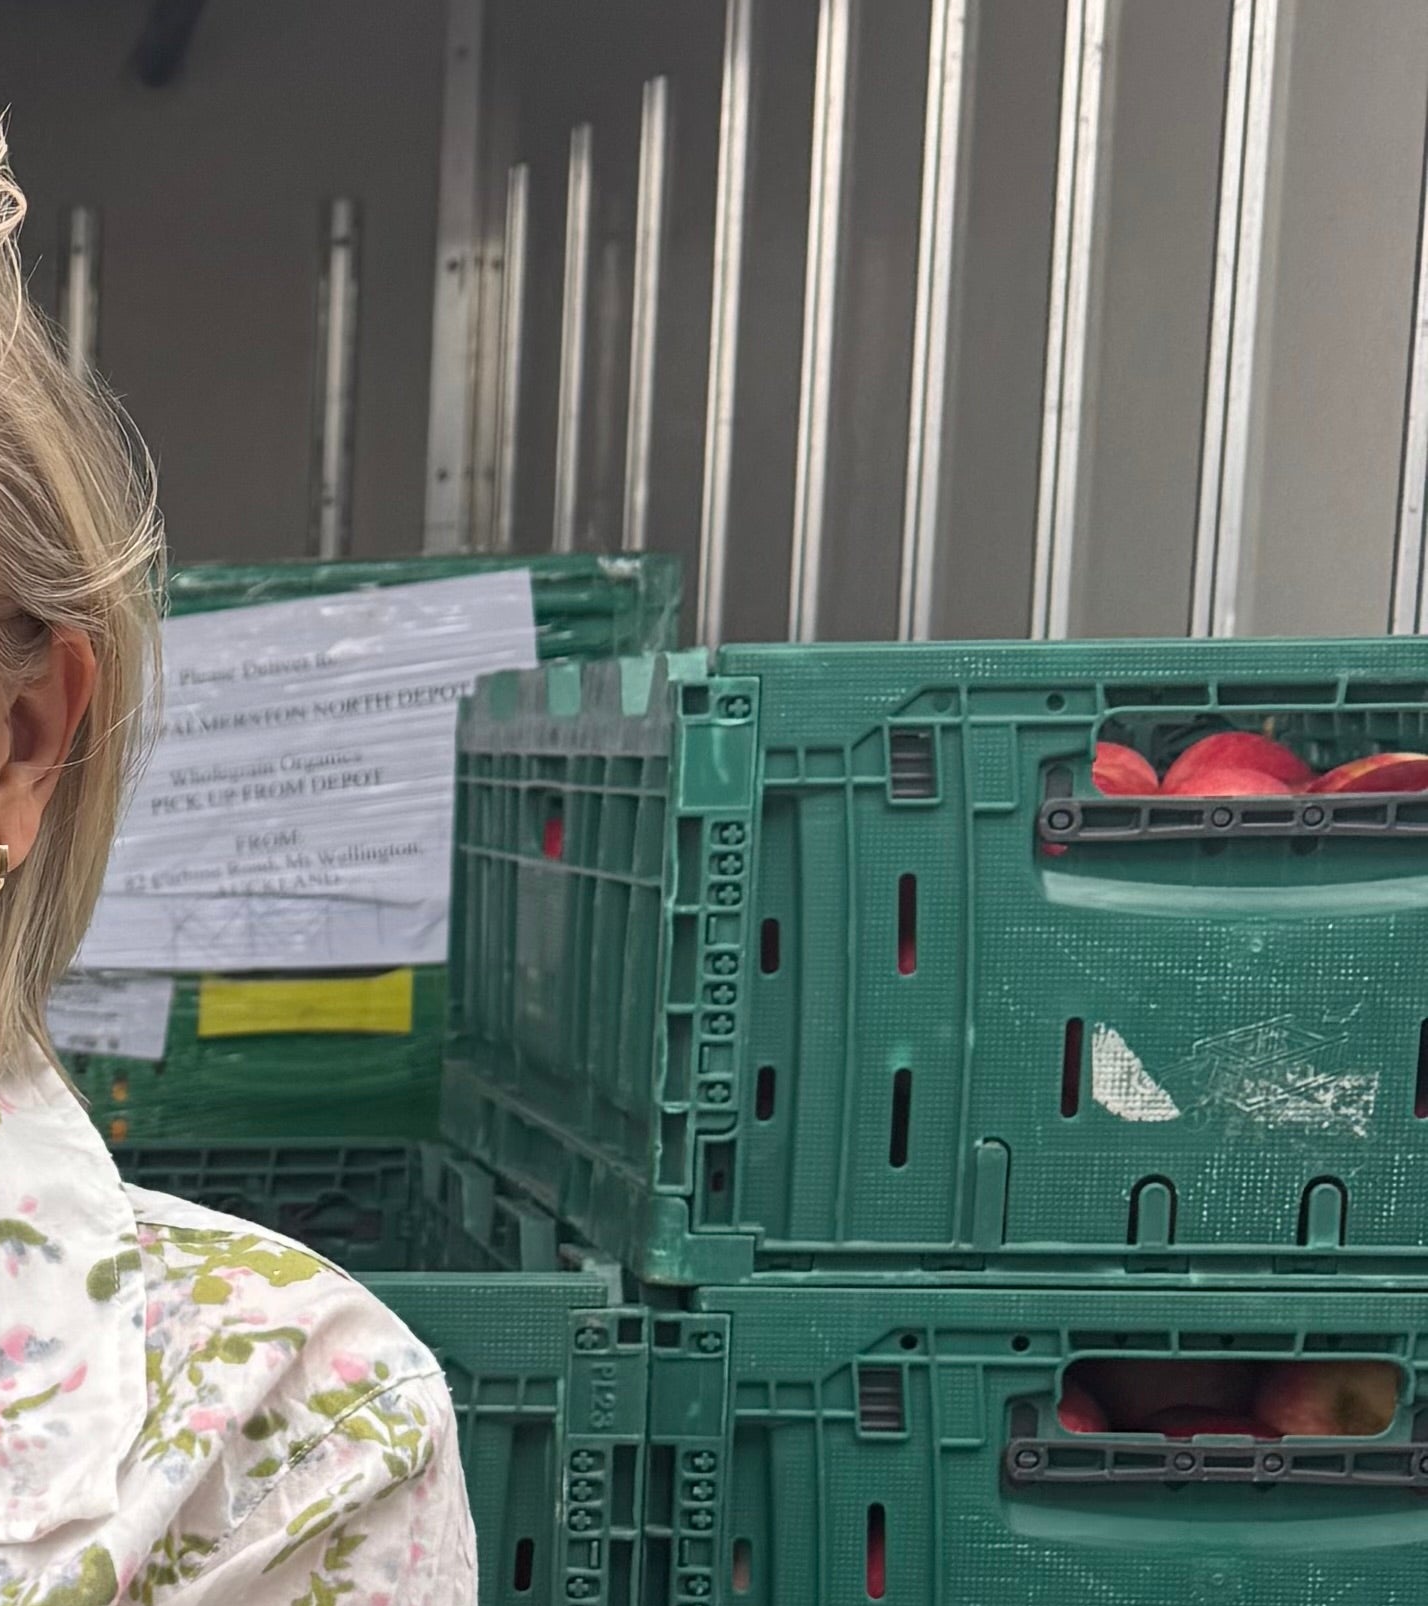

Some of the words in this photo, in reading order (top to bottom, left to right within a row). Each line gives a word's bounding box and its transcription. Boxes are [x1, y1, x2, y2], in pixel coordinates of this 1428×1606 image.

[312, 692, 393, 716] NORTH
[151, 795, 202, 816] PICK
[207, 788, 237, 808] UP
[240, 777, 304, 802] FROM
[310, 768, 383, 794] DEPOT
